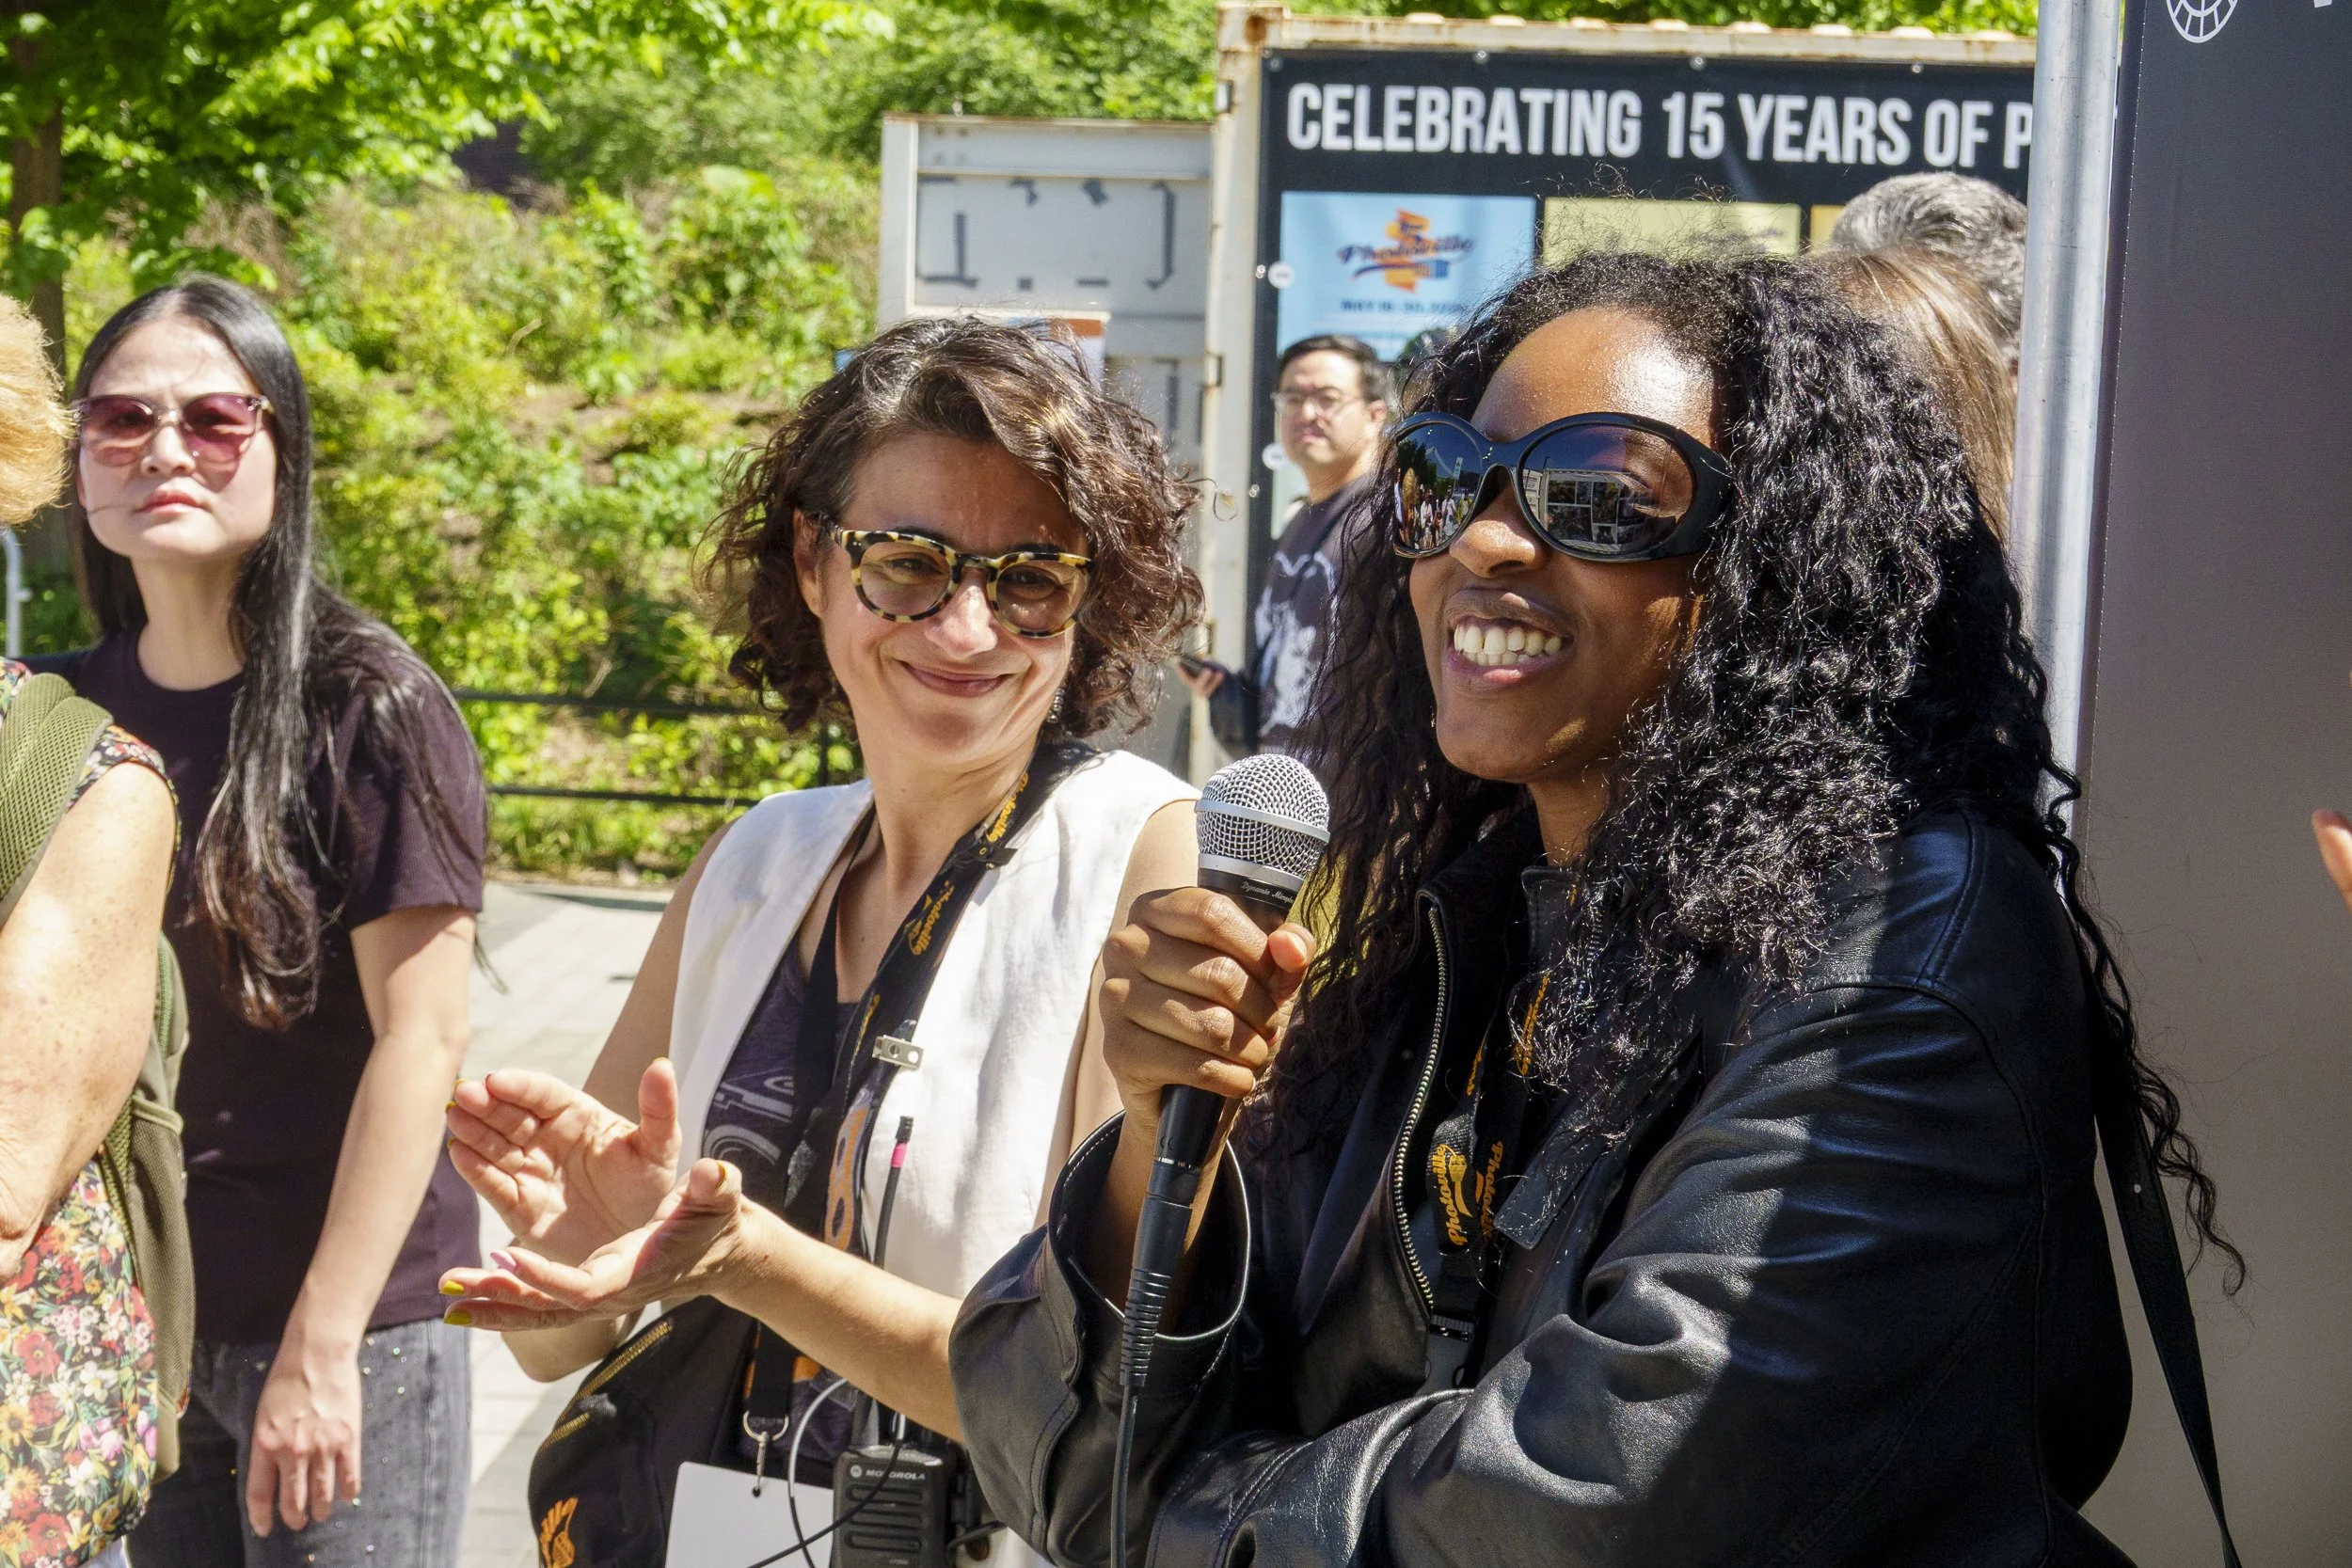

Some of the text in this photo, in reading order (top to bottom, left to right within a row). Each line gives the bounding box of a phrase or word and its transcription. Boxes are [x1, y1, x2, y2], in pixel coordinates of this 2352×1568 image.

[1286, 82, 1643, 159] CELEBRATING
[1661, 90, 1725, 161] 15
[1737, 92, 1914, 166] YEARS
[1923, 98, 1994, 168] OF
[1241, 880, 1271, 896] Dynamic
[1431, 1143, 1469, 1246] Photoville
[865, 1468, 927, 1481] MOOROLA
